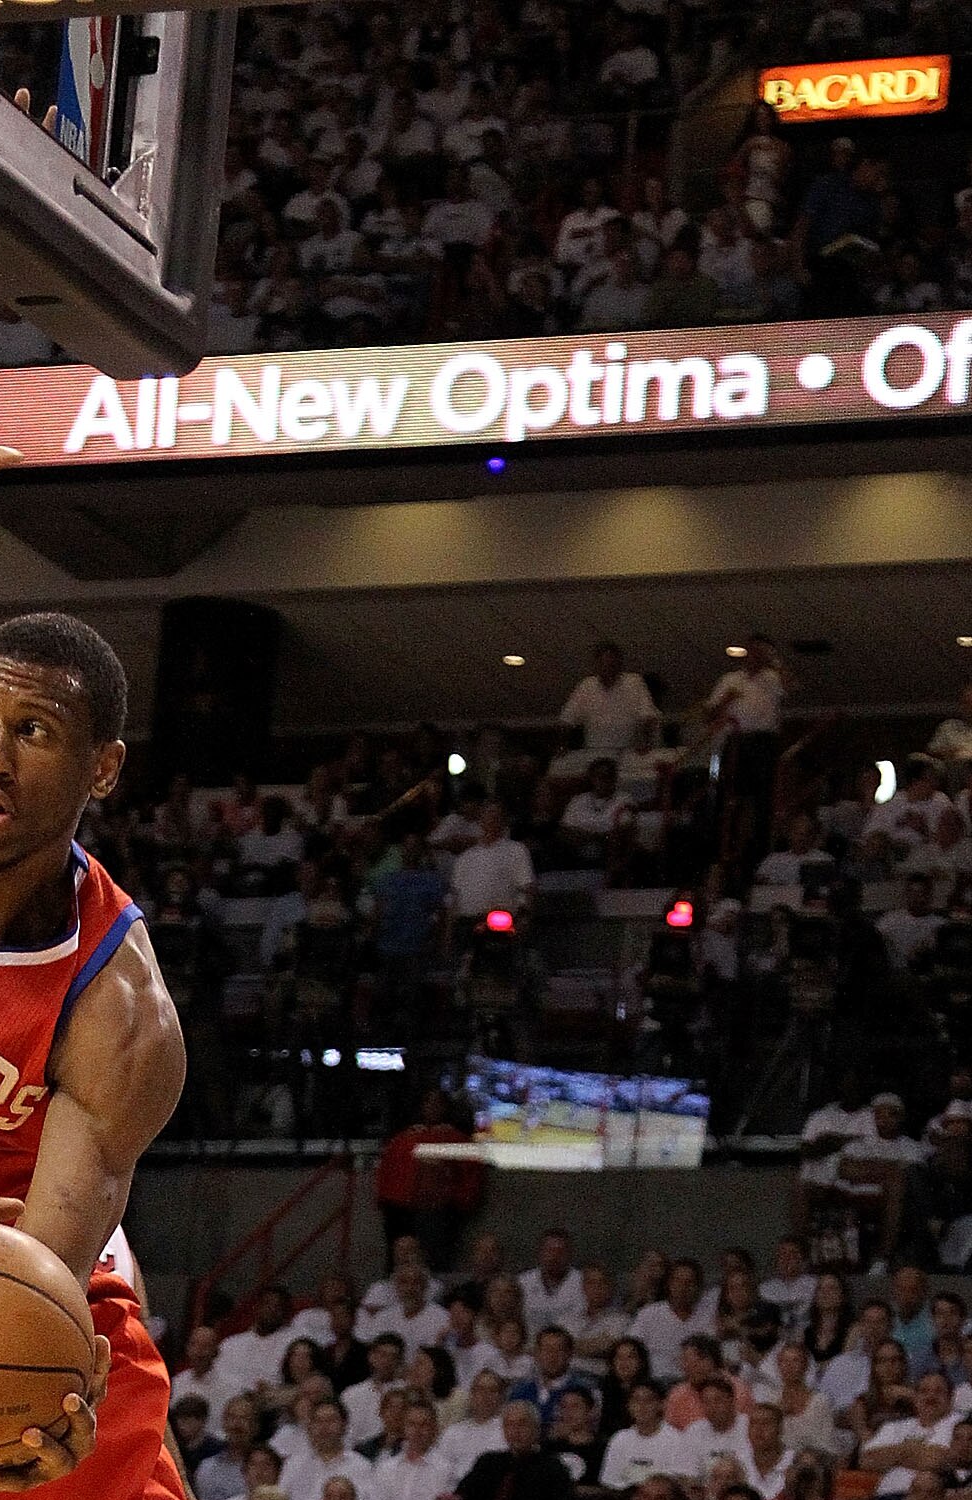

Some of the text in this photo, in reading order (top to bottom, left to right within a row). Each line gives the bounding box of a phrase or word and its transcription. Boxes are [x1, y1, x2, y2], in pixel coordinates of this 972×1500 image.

[763, 67, 941, 113] BACARDI
[63, 363, 410, 452] All-New
[429, 341, 770, 443] Optima
